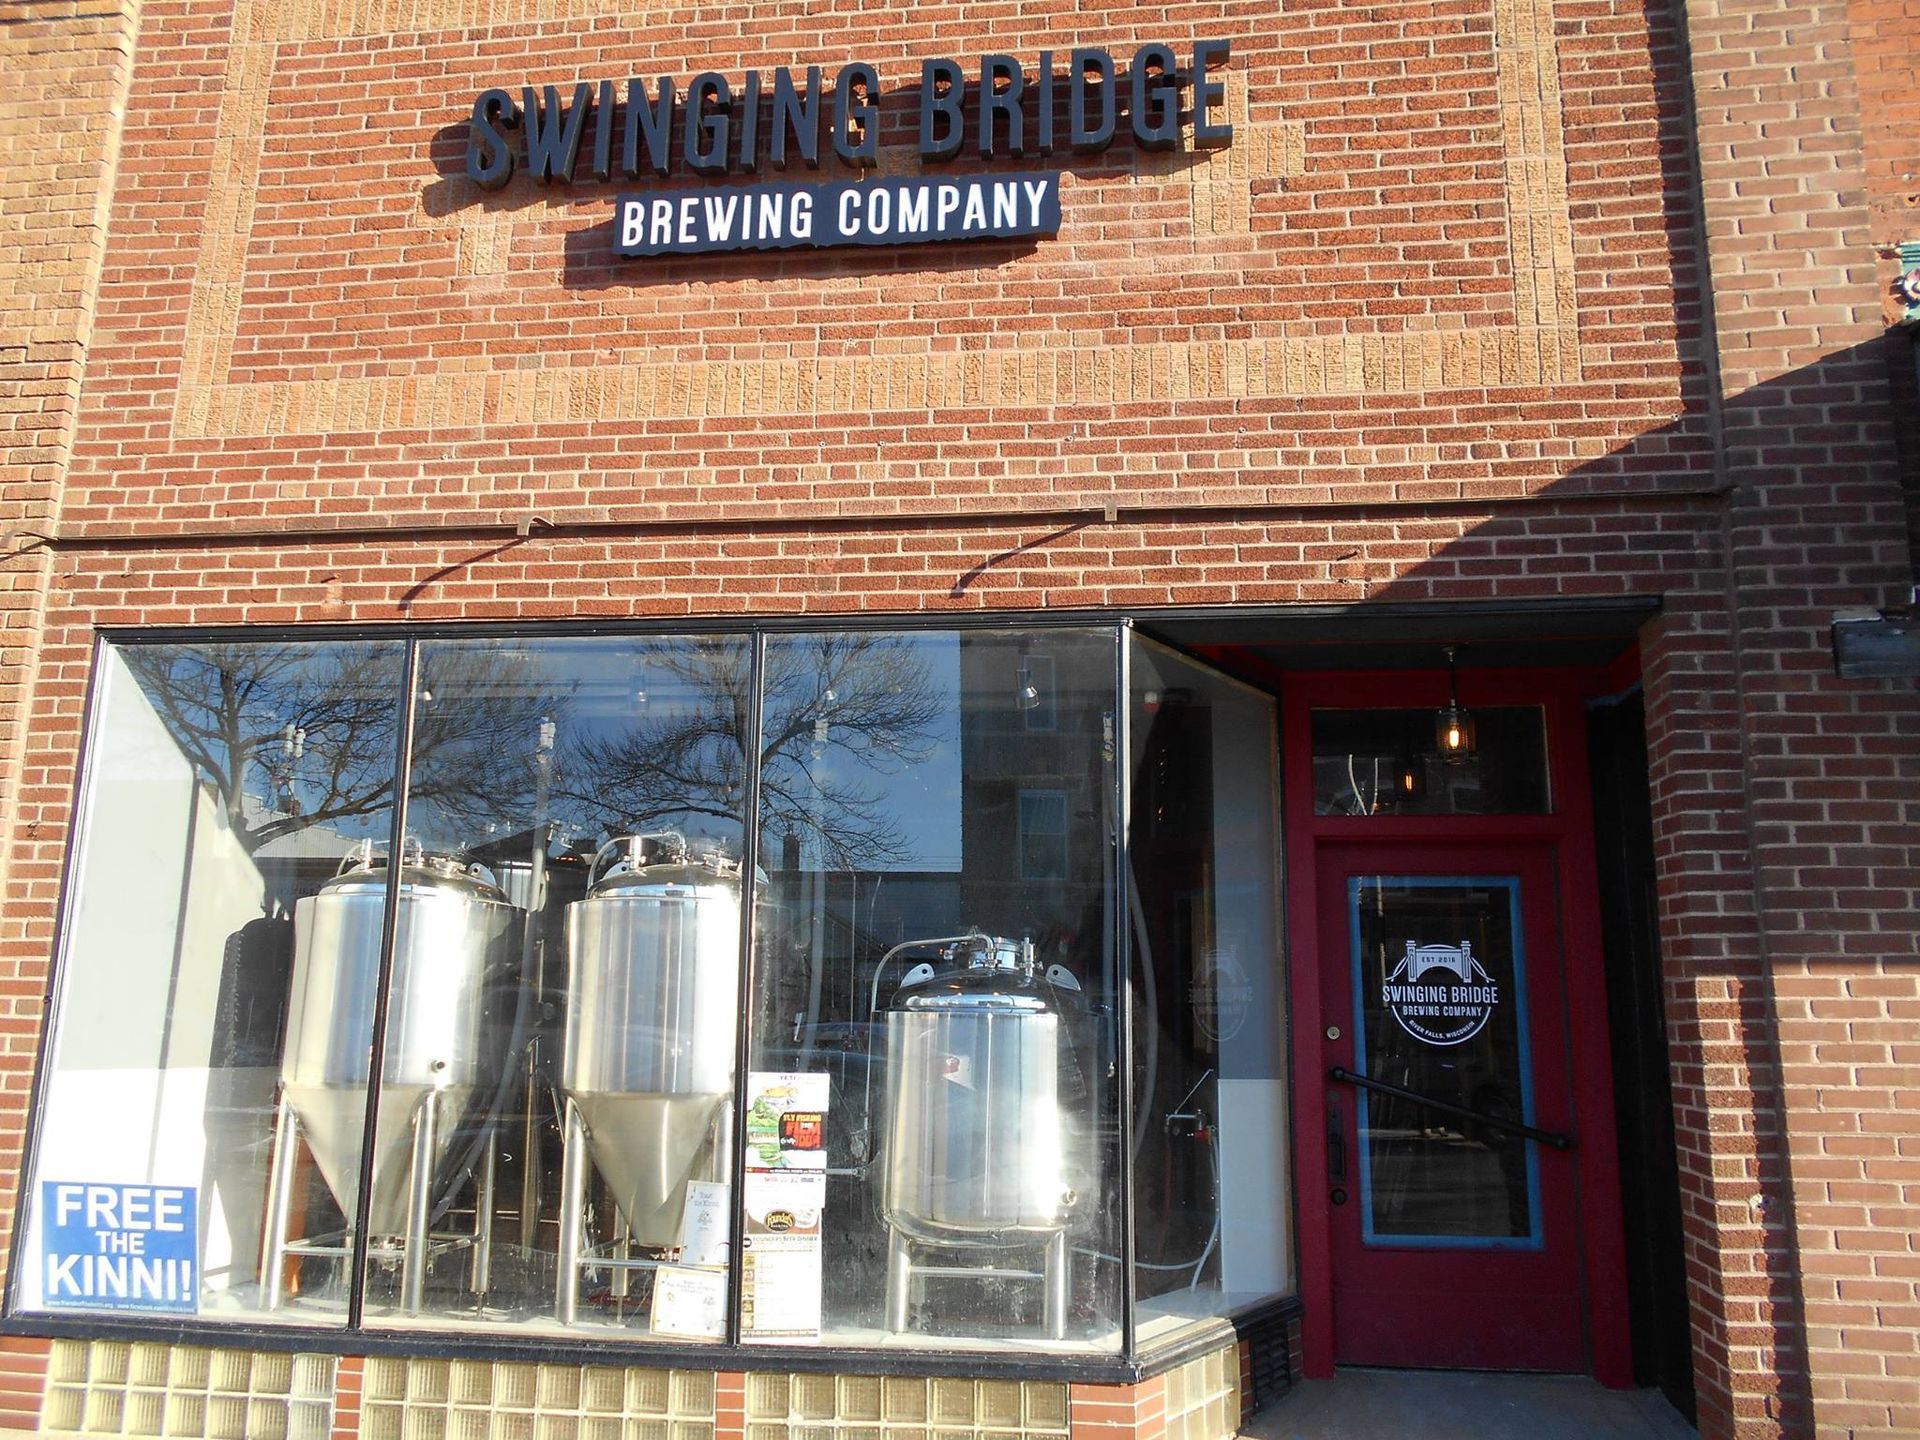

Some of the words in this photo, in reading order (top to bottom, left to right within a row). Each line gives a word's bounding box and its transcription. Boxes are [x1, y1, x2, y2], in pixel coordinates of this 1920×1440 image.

[465, 61, 880, 190] SWINGING
[920, 38, 1233, 164] BRIDGE
[621, 190, 812, 247] BREWING
[838, 180, 1048, 236] COMPANY
[1383, 986, 1447, 1002] SWINGING
[1451, 986, 1498, 1003] BRIDGE
[1402, 1005, 1440, 1016] BREWING
[1443, 1006, 1482, 1017] COMPANY
[1409, 1020, 1425, 1032] RIVER
[1446, 1021, 1475, 1038] WISCONSIN
[56, 1184, 184, 1232] FREE
[95, 1230, 146, 1255] THE
[47, 1253, 192, 1301] KINNI!
